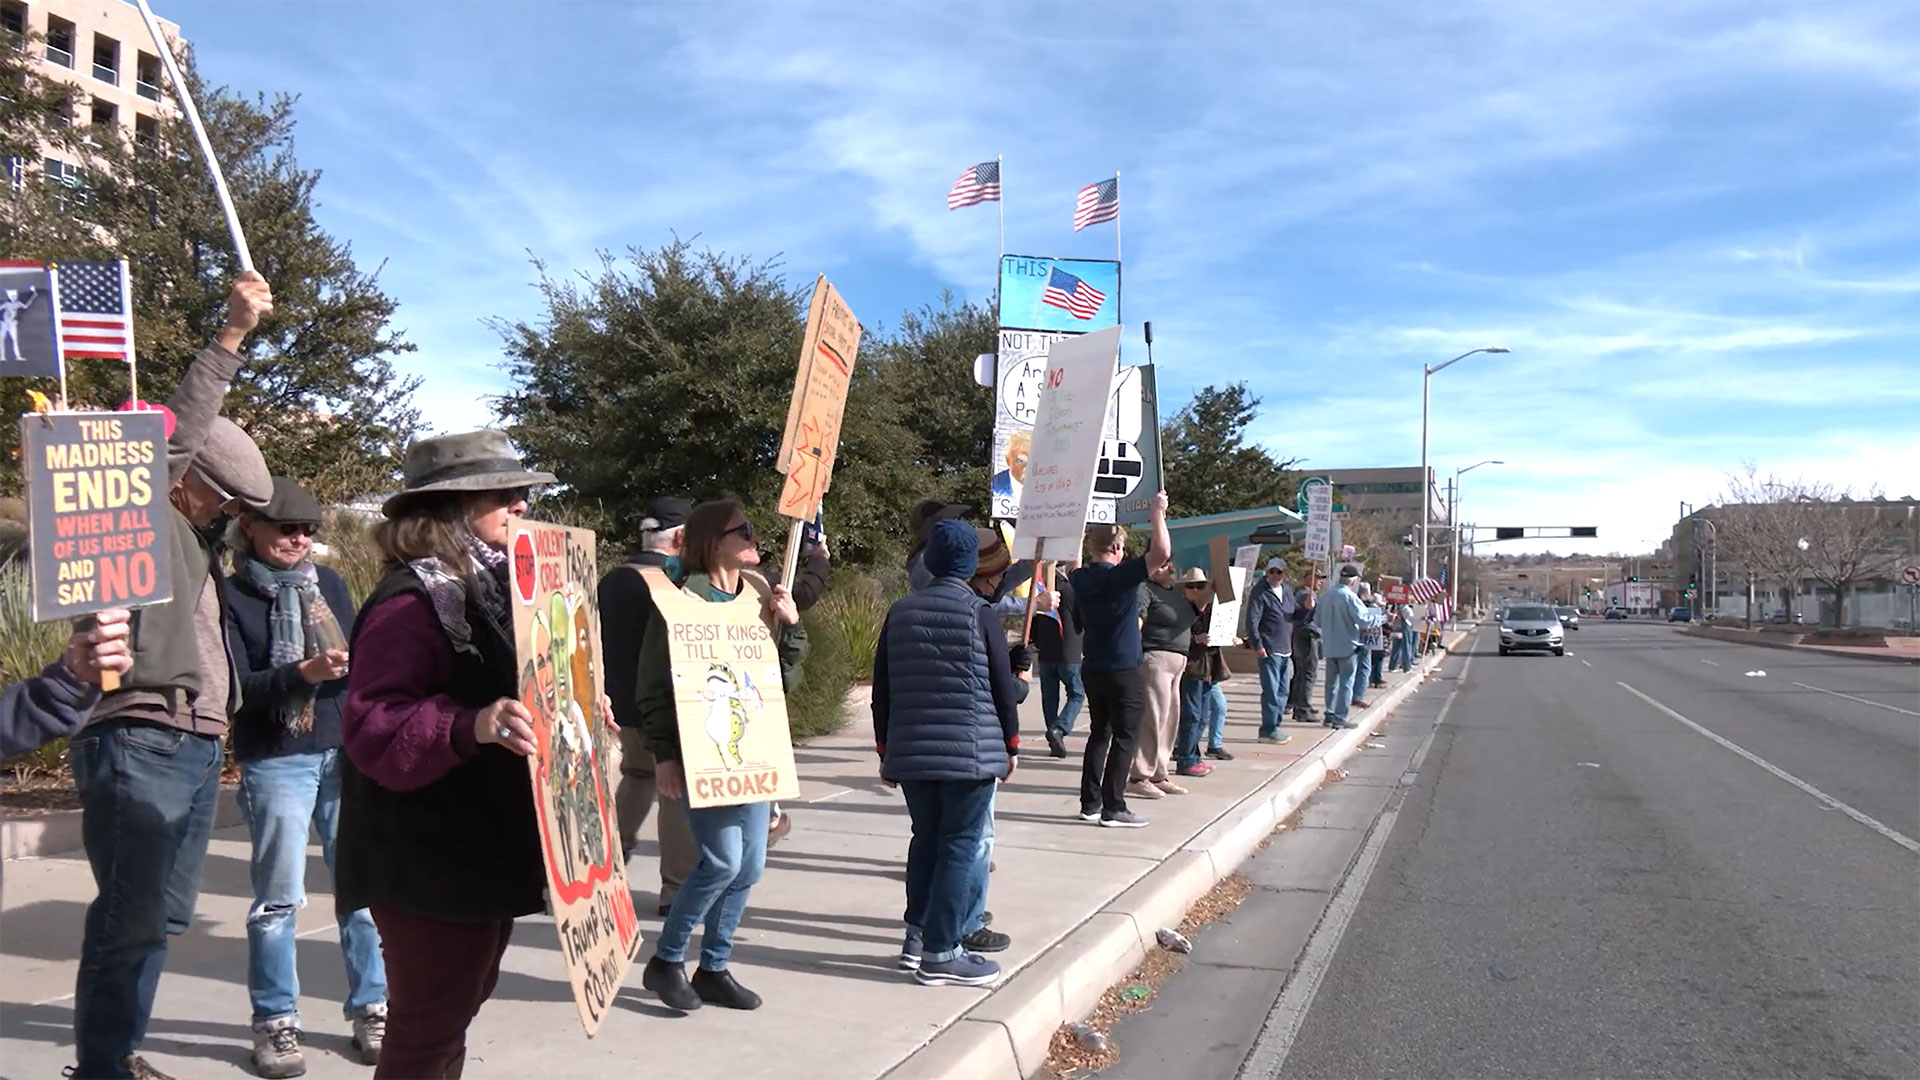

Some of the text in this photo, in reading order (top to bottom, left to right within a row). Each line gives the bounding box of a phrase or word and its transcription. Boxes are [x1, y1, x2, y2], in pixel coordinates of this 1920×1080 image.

[1005, 258, 1048, 277] THIS
[1002, 333, 1032, 350] NOT
[1022, 362, 1046, 379] Ar
[1047, 368, 1064, 389] NO
[1016, 382, 1025, 399] A
[1015, 401, 1036, 418] Pr
[79, 420, 122, 441] THIS
[46, 441, 154, 469] MADNESS
[53, 466, 152, 513] ENDS
[56, 509, 152, 538] WHEN ALL
[53, 530, 156, 559] OF US RISE UP
[58, 559, 94, 581] AND
[100, 551, 156, 603] NO
[515, 554, 535, 579] STOP
[58, 581, 95, 606] SAY
[673, 623, 768, 642] RESIST KINGS
[684, 643, 762, 660] TILL YOU
[695, 771, 778, 799] CROAK!
[561, 905, 599, 966] TRUMP
[598, 890, 615, 937] GO
